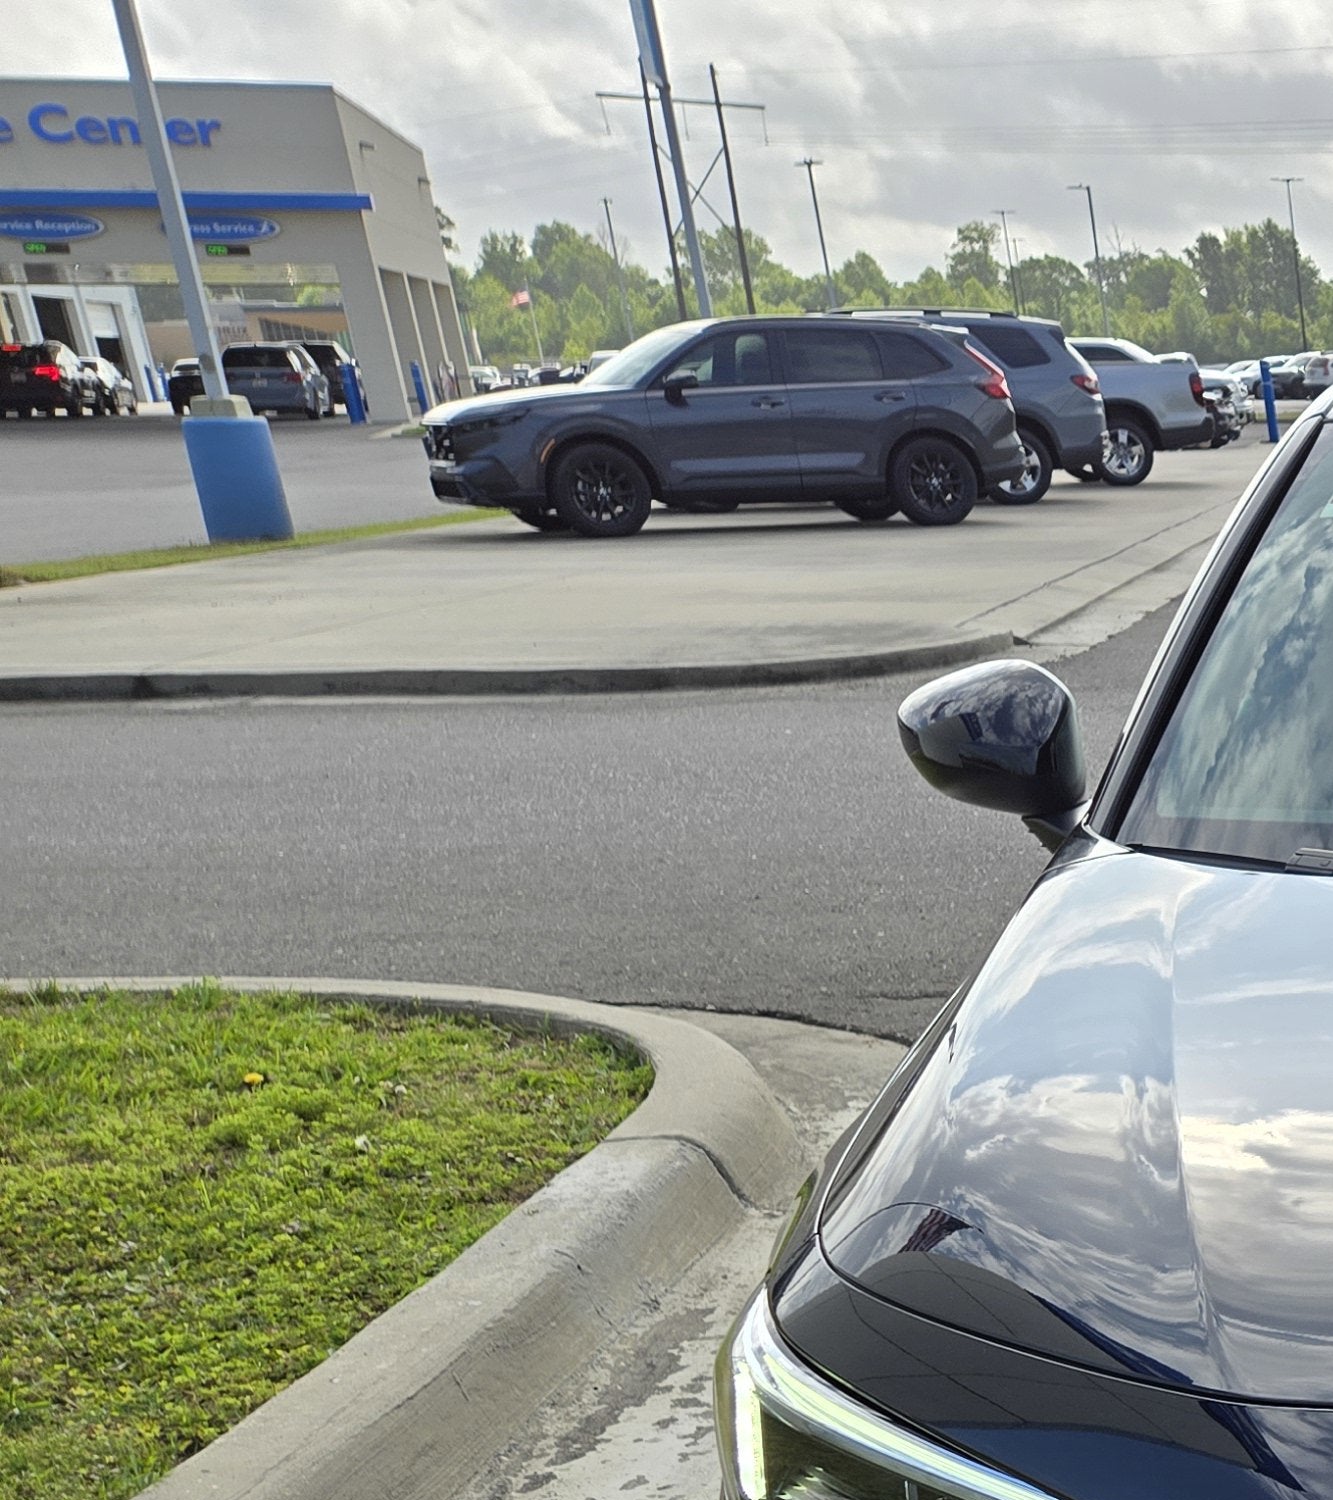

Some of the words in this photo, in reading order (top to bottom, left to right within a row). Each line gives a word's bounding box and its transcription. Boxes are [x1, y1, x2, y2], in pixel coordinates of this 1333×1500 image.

[28, 102, 222, 147] Cener
[34, 218, 96, 233] Reception
[212, 221, 255, 234] Service
